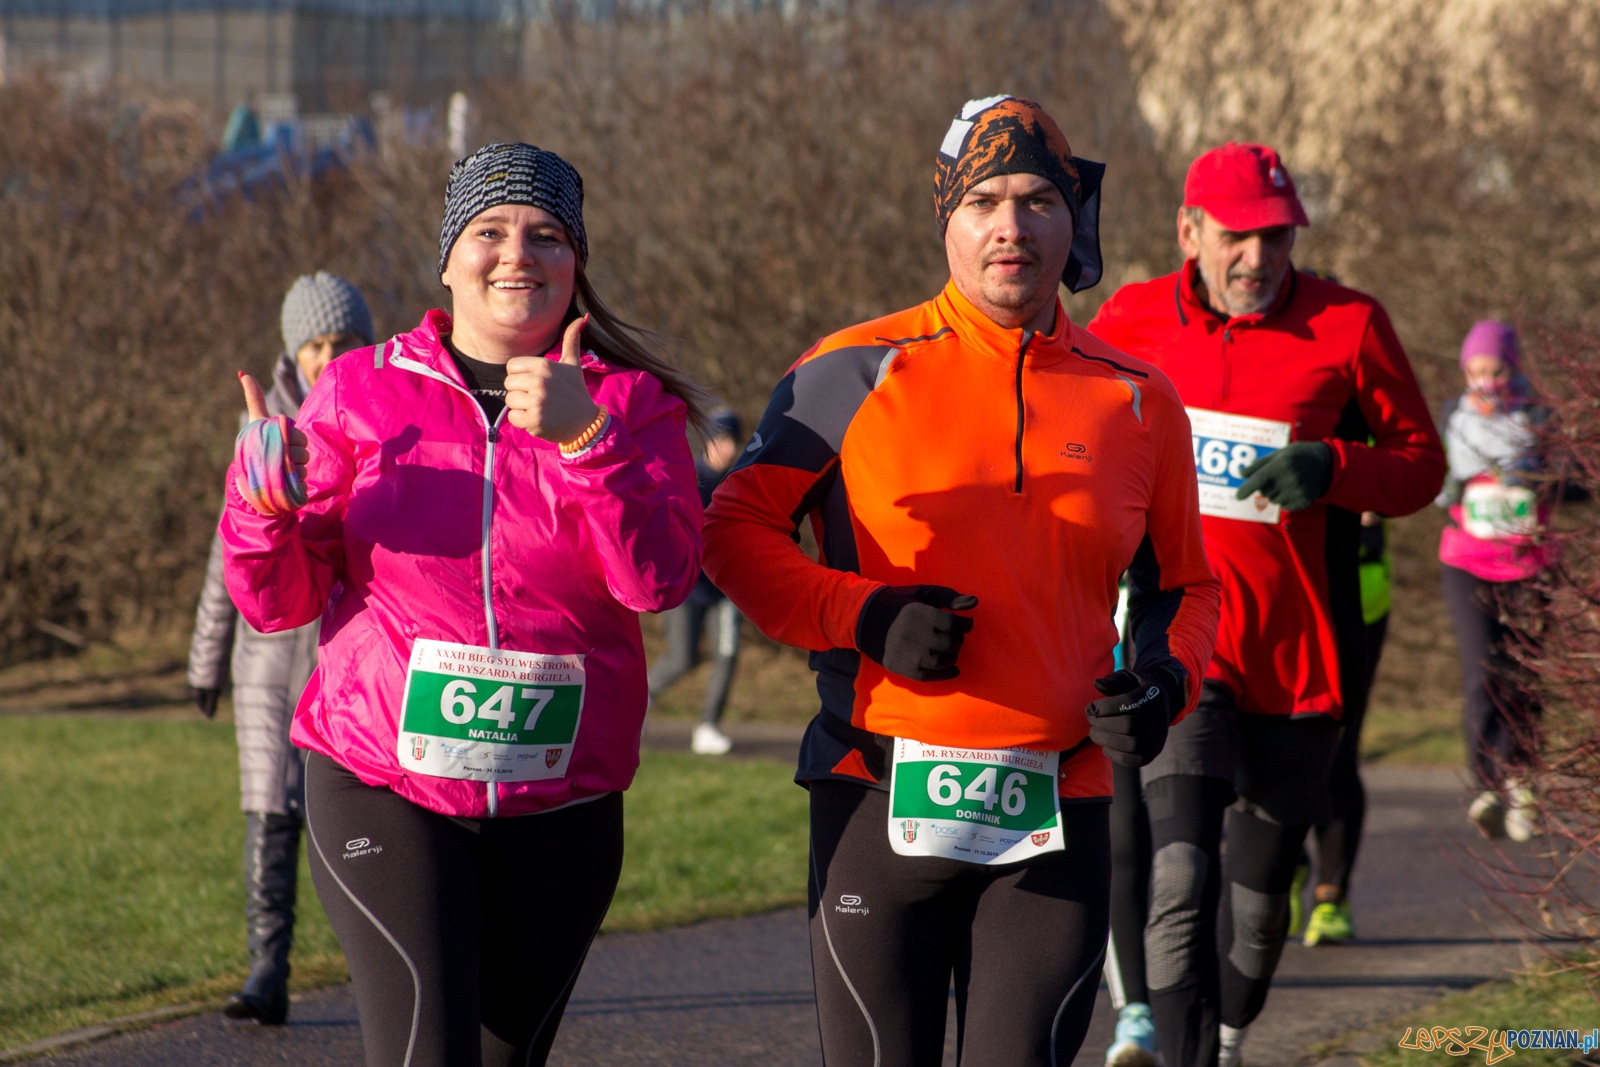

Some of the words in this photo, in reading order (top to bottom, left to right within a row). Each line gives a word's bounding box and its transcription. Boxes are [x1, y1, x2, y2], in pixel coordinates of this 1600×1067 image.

[485, 172, 509, 183] KTM
[504, 173, 532, 182] KTM
[505, 183, 532, 192] KTM
[483, 190, 508, 203] KTM
[505, 193, 532, 202] KTM
[1060, 451, 1093, 462] Kalenji
[435, 649, 466, 660] XXXII
[468, 651, 495, 664] BIEG
[497, 656, 577, 670] SYLWESTROWY
[438, 661, 454, 672] IM.
[457, 665, 517, 679] RYSZARDA
[519, 672, 571, 682] BURGIELA
[440, 679, 555, 731] 647
[1119, 696, 1149, 712] Kalenji
[468, 728, 519, 742] NATALIA
[921, 750, 938, 758] IM.
[941, 750, 999, 762] RYSZARDA
[1001, 754, 1044, 770] BURGIELA
[926, 763, 1028, 817] 646
[956, 809, 1001, 824] DOMINIK
[935, 826, 959, 835] posir
[342, 845, 383, 860] Kalenji
[835, 905, 870, 916] Kalenji
